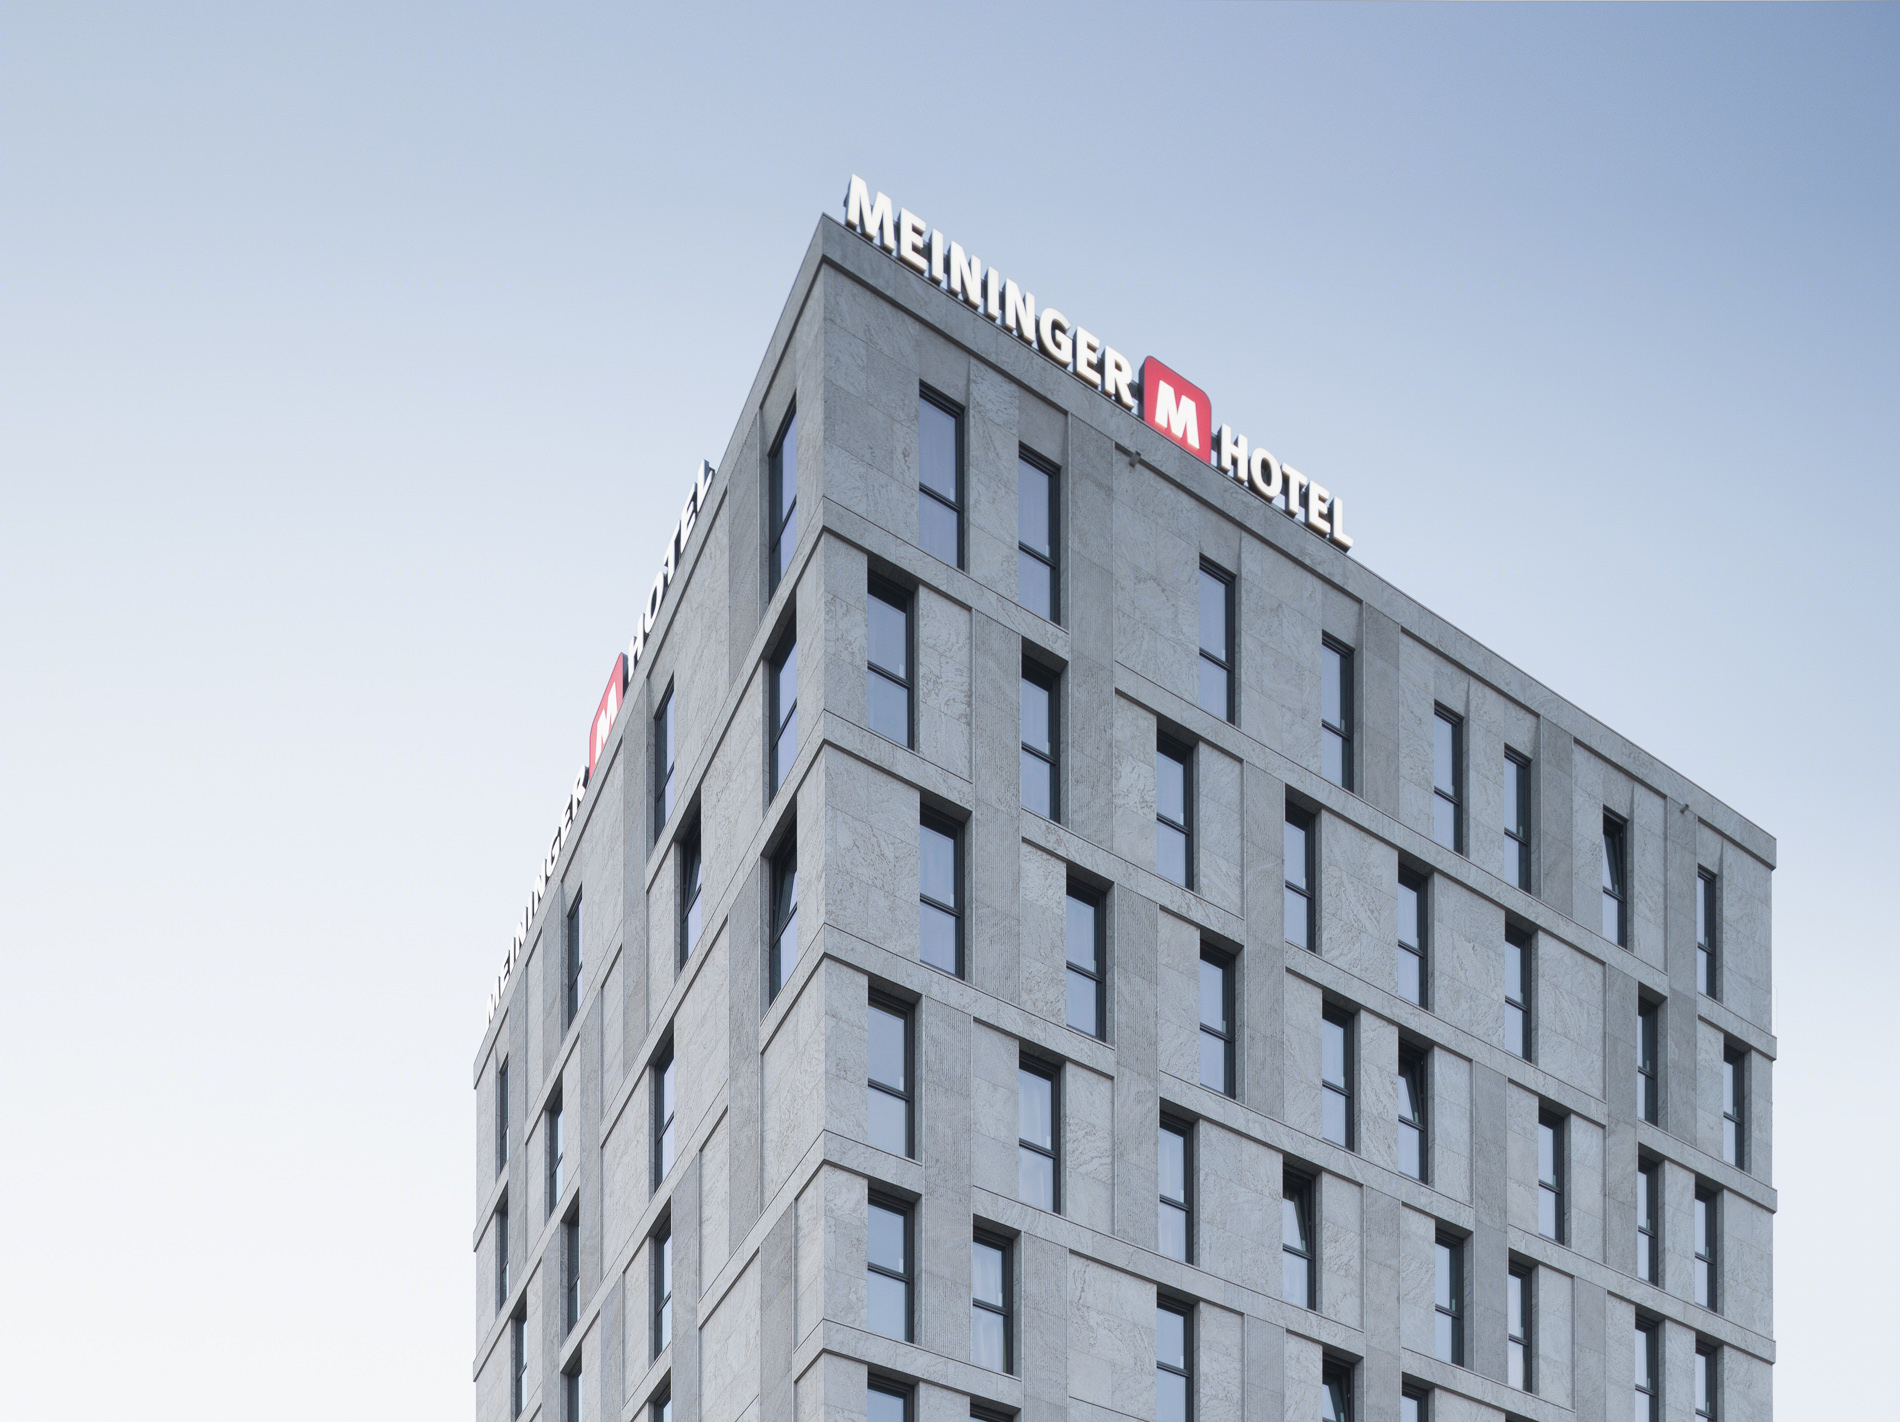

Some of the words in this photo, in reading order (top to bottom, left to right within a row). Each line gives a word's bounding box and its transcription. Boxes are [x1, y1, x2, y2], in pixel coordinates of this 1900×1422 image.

[844, 173, 1135, 411] MEININGER
[1154, 378, 1200, 450] M
[1217, 422, 1354, 554] HOTEL
[485, 764, 589, 1030] MEININGER
[628, 458, 716, 683] HOTEL
